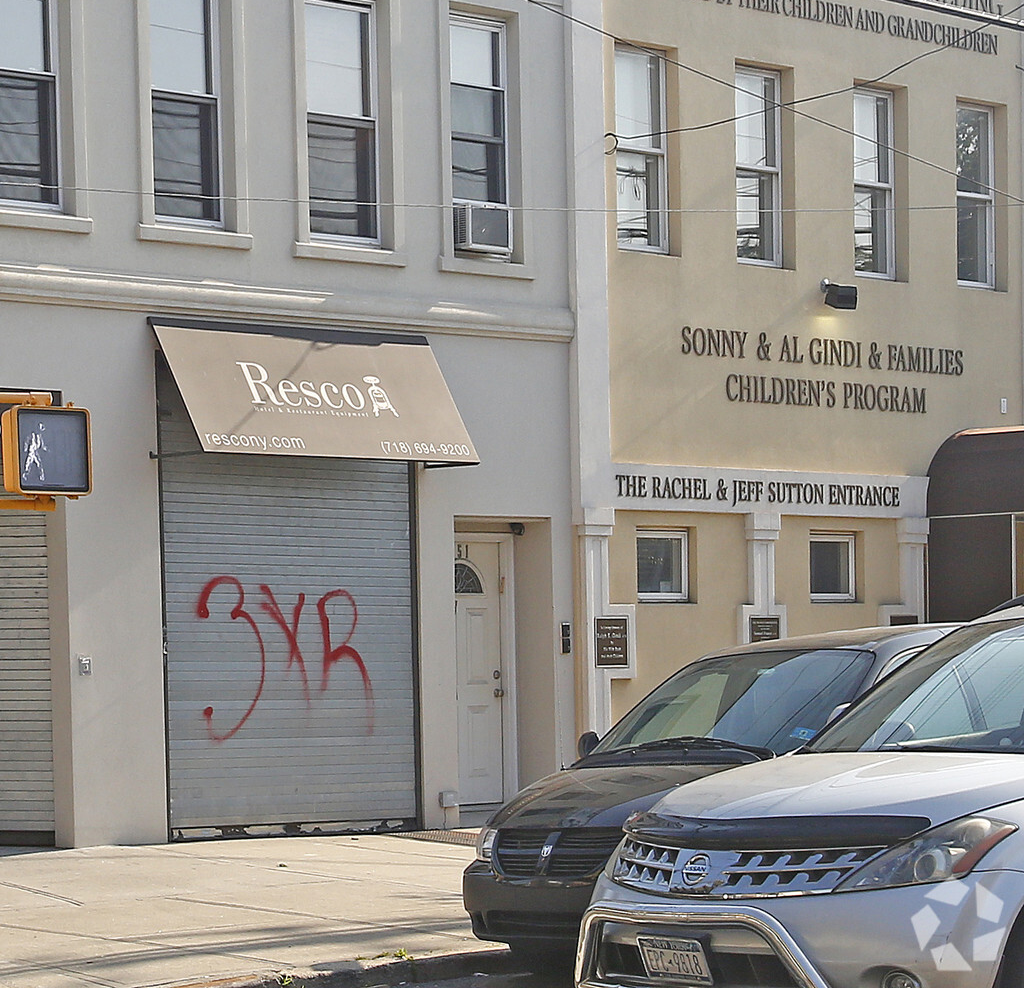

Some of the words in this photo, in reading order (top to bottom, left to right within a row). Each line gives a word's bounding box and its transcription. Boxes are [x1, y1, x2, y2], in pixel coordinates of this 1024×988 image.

[855, 7, 885, 34] AND
[887, 14, 998, 56] GRANDCHILDREN
[681, 325, 748, 359] SONNY
[756, 332, 772, 362] &
[778, 334, 804, 365] AL
[808, 338, 863, 369] GINDI
[868, 342, 883, 370] &
[887, 344, 964, 376] FAMILIES
[235, 361, 365, 410] Resco
[725, 373, 836, 409] CHILDREN'S
[842, 381, 927, 414] PROGRAM
[204, 432, 306, 450] rescony.com
[380, 441, 412, 455] (718)
[413, 442, 470, 457] 694-9200
[615, 474, 648, 498] THE
[652, 476, 712, 500] RACHEL
[716, 478, 729, 501] &
[731, 479, 764, 507] JEFF
[768, 481, 824, 505] SUTTON
[828, 484, 900, 508] ENTRANCE
[684, 864, 708, 873] NISSAN
